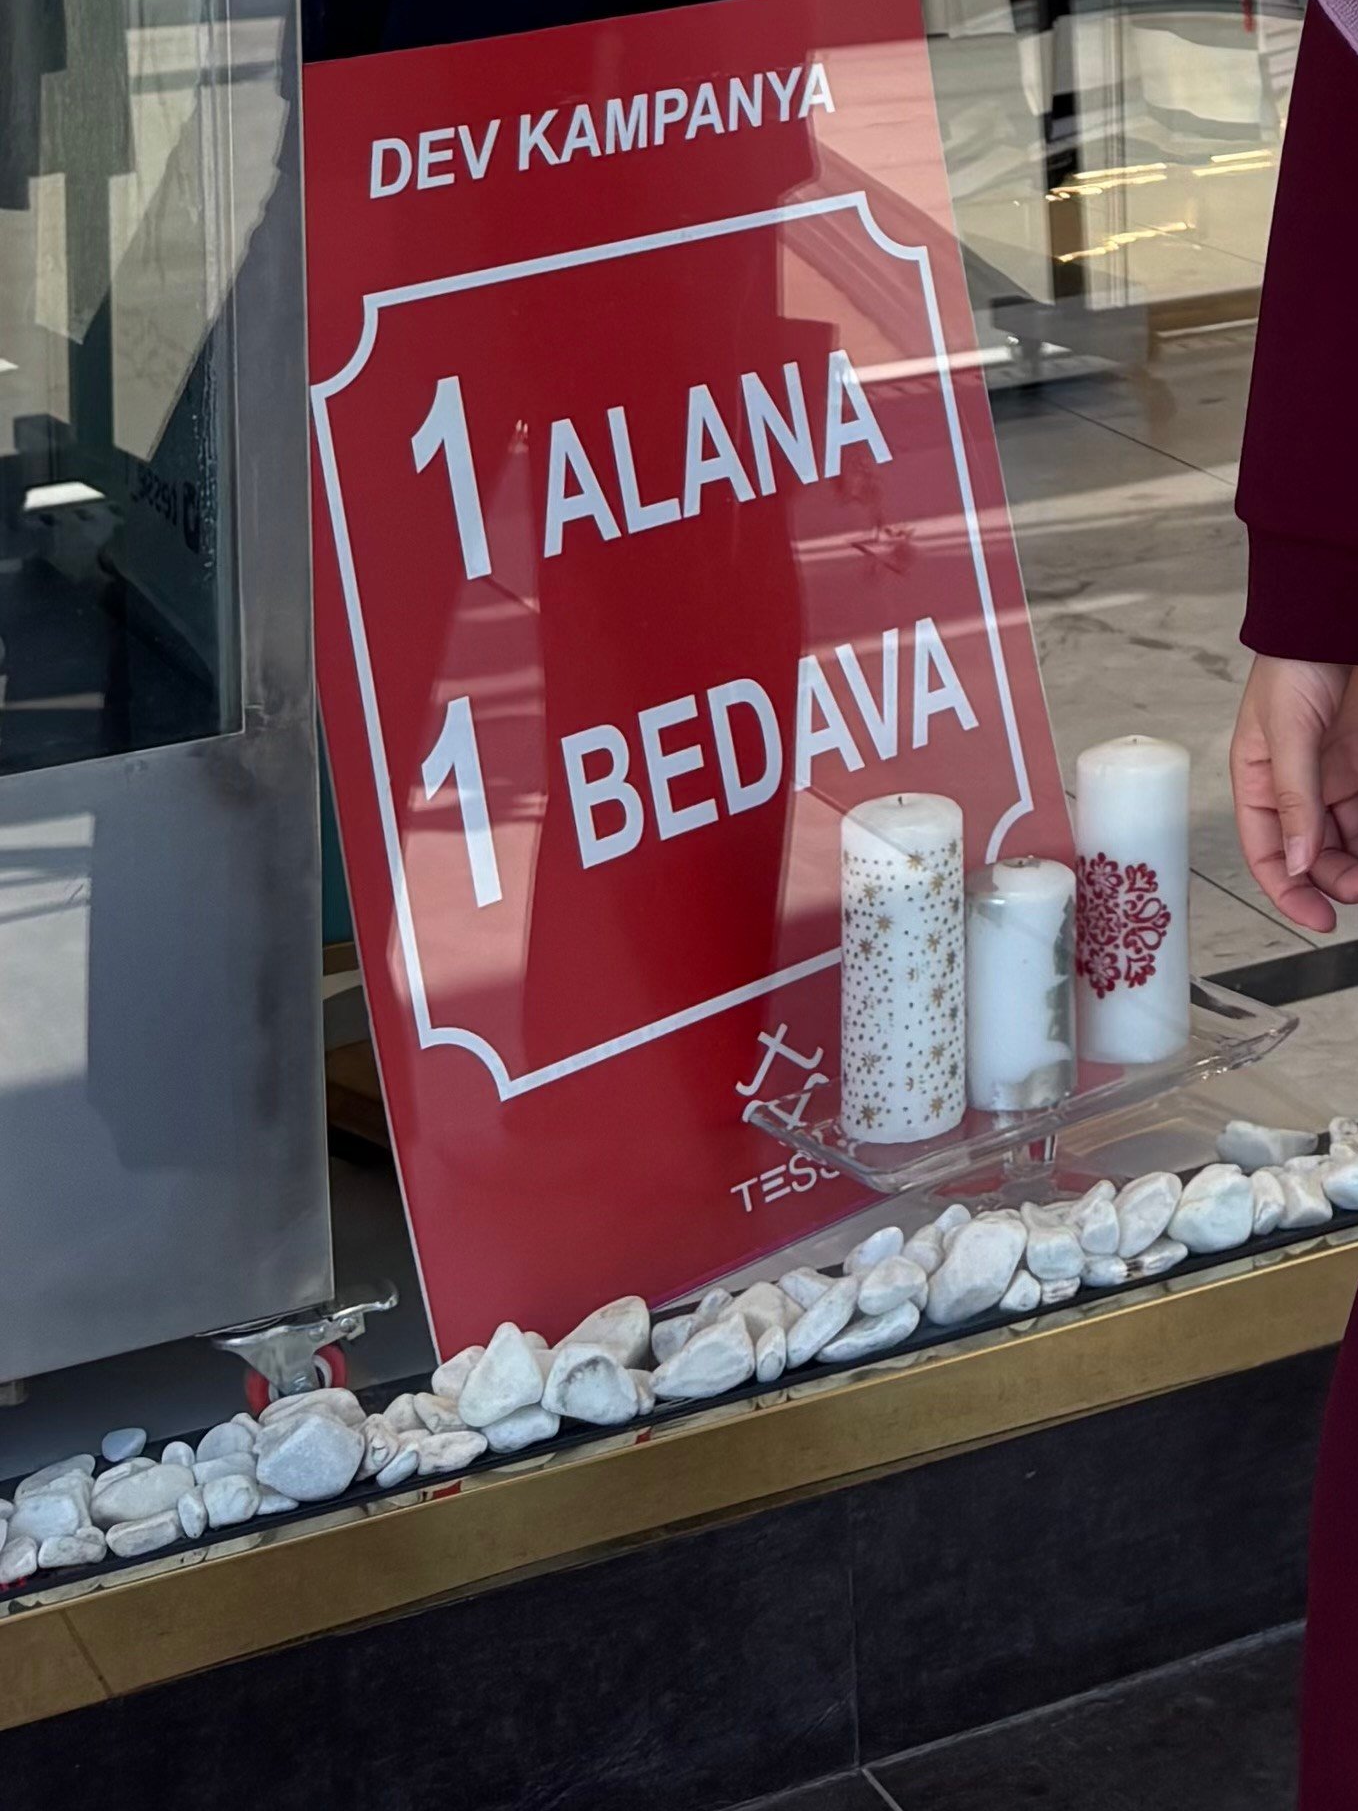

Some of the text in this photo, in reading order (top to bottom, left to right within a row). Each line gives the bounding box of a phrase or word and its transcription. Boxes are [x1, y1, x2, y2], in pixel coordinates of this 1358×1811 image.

[370, 62, 836, 199] DEV KAMPANYA
[411, 349, 892, 580] 1 ALANA
[421, 616, 979, 908] 1 BEDAVA
